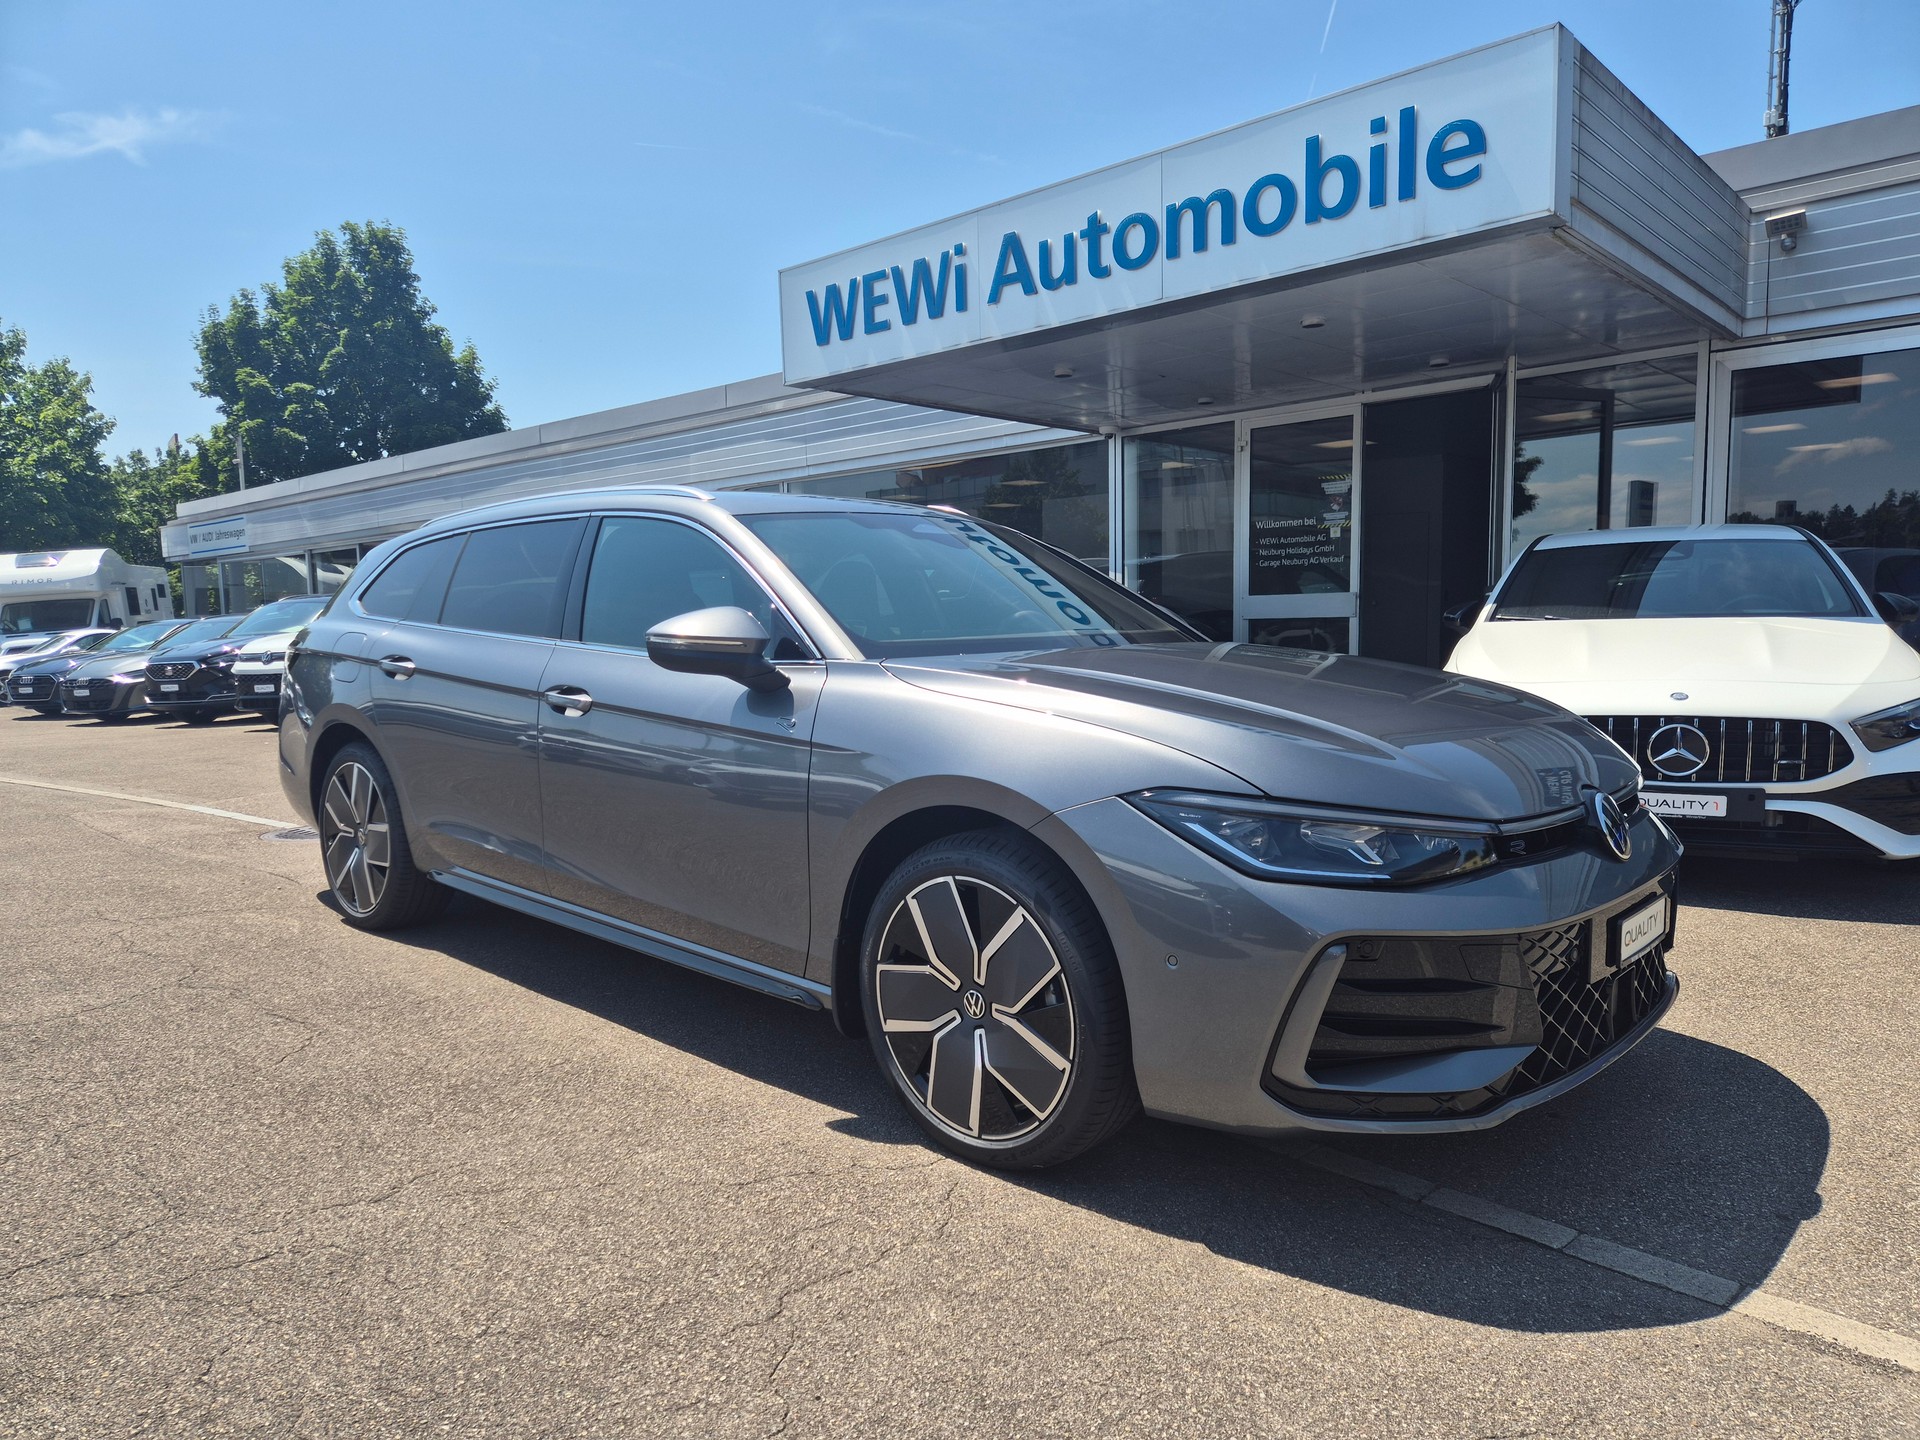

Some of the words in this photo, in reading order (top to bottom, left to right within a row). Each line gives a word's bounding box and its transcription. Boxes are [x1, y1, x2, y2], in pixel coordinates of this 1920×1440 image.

[805, 243, 968, 346] WEWi
[987, 104, 1487, 305] Automobile
[1256, 519, 1303, 529] Willkommen
[1304, 517, 1316, 526] bei
[1259, 537, 1279, 545] WEWi
[1280, 535, 1316, 544] Automobile
[1259, 548, 1286, 557] Neuburg
[1286, 546, 1314, 555] Holidays
[1314, 545, 1335, 553] GmbH
[1259, 559, 1280, 568] Garage
[1281, 557, 1309, 566] Neuburg
[1309, 556, 1319, 564] AG
[1319, 555, 1344, 563] Verkauf
[11, 577, 53, 585] RIMOR
[1624, 911, 1659, 948] QUALITY
